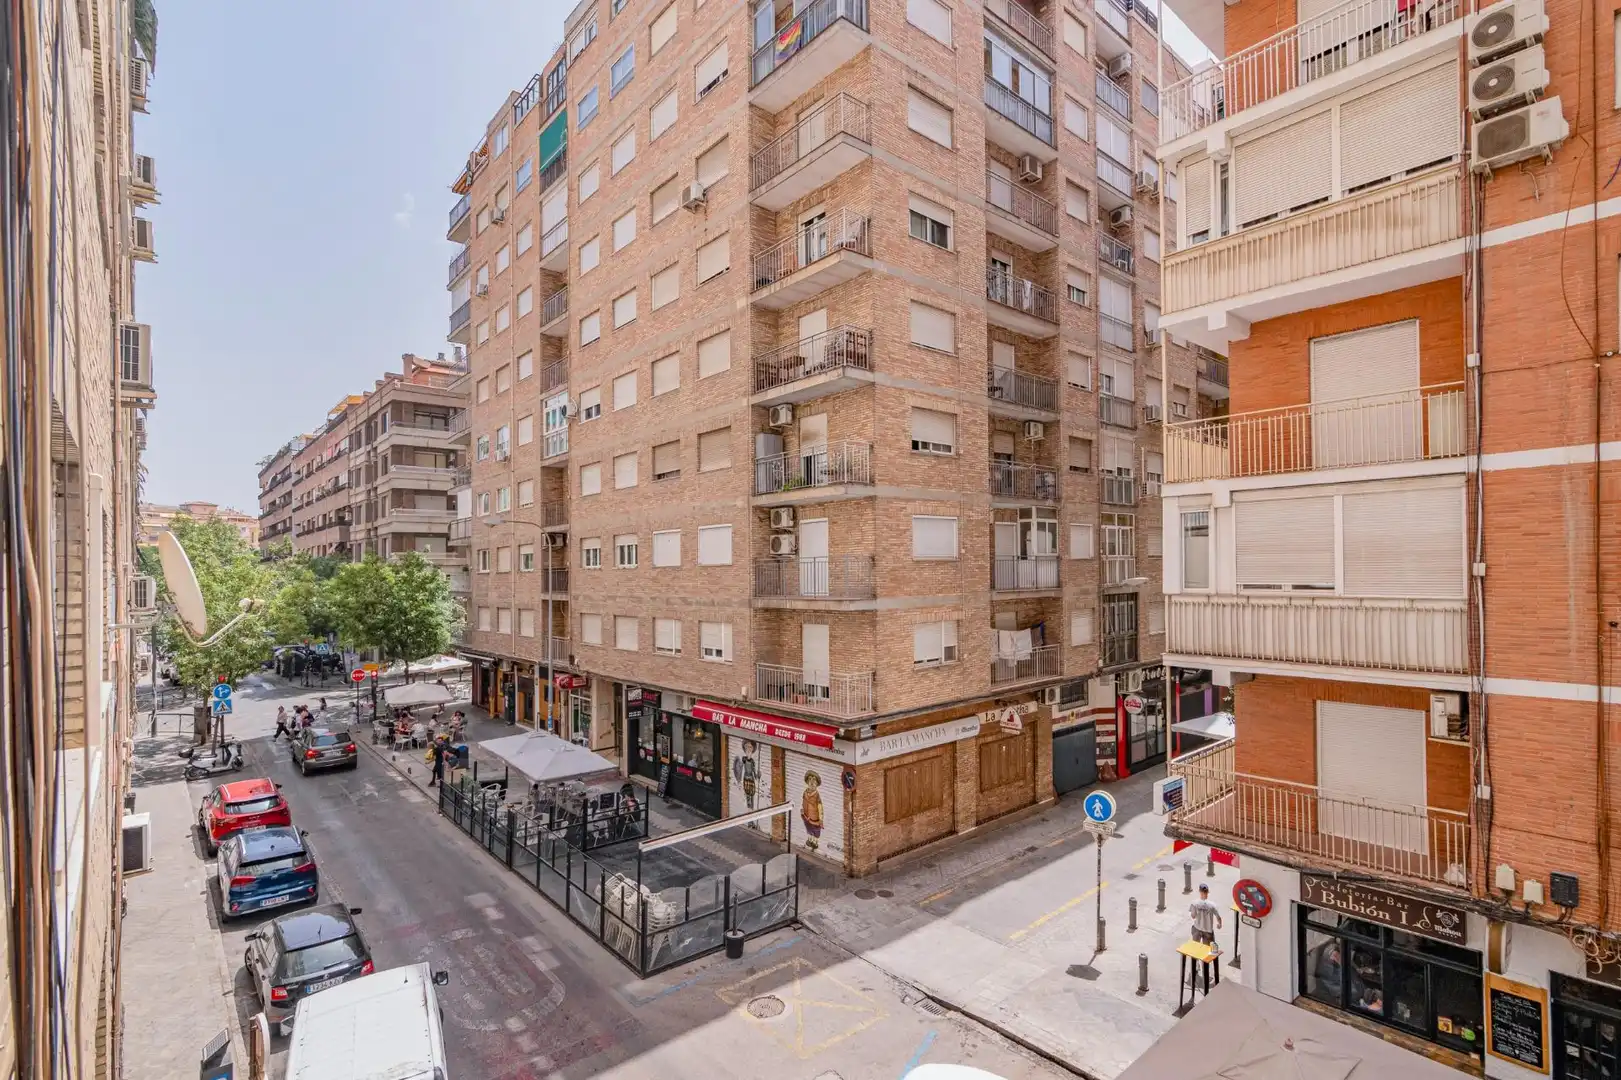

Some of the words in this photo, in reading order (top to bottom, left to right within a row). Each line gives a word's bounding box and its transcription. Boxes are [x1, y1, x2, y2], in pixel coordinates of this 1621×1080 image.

[712, 712, 724, 724] BAR
[728, 715, 736, 726] LA
[740, 718, 768, 733] MANCHA
[985, 711, 996, 723] La
[879, 738, 898, 752] BAR
[899, 736, 911, 749] LA
[912, 727, 947, 745] MANCHA
[1320, 889, 1392, 922] Bubión
[1434, 924, 1462, 937] Mahou
